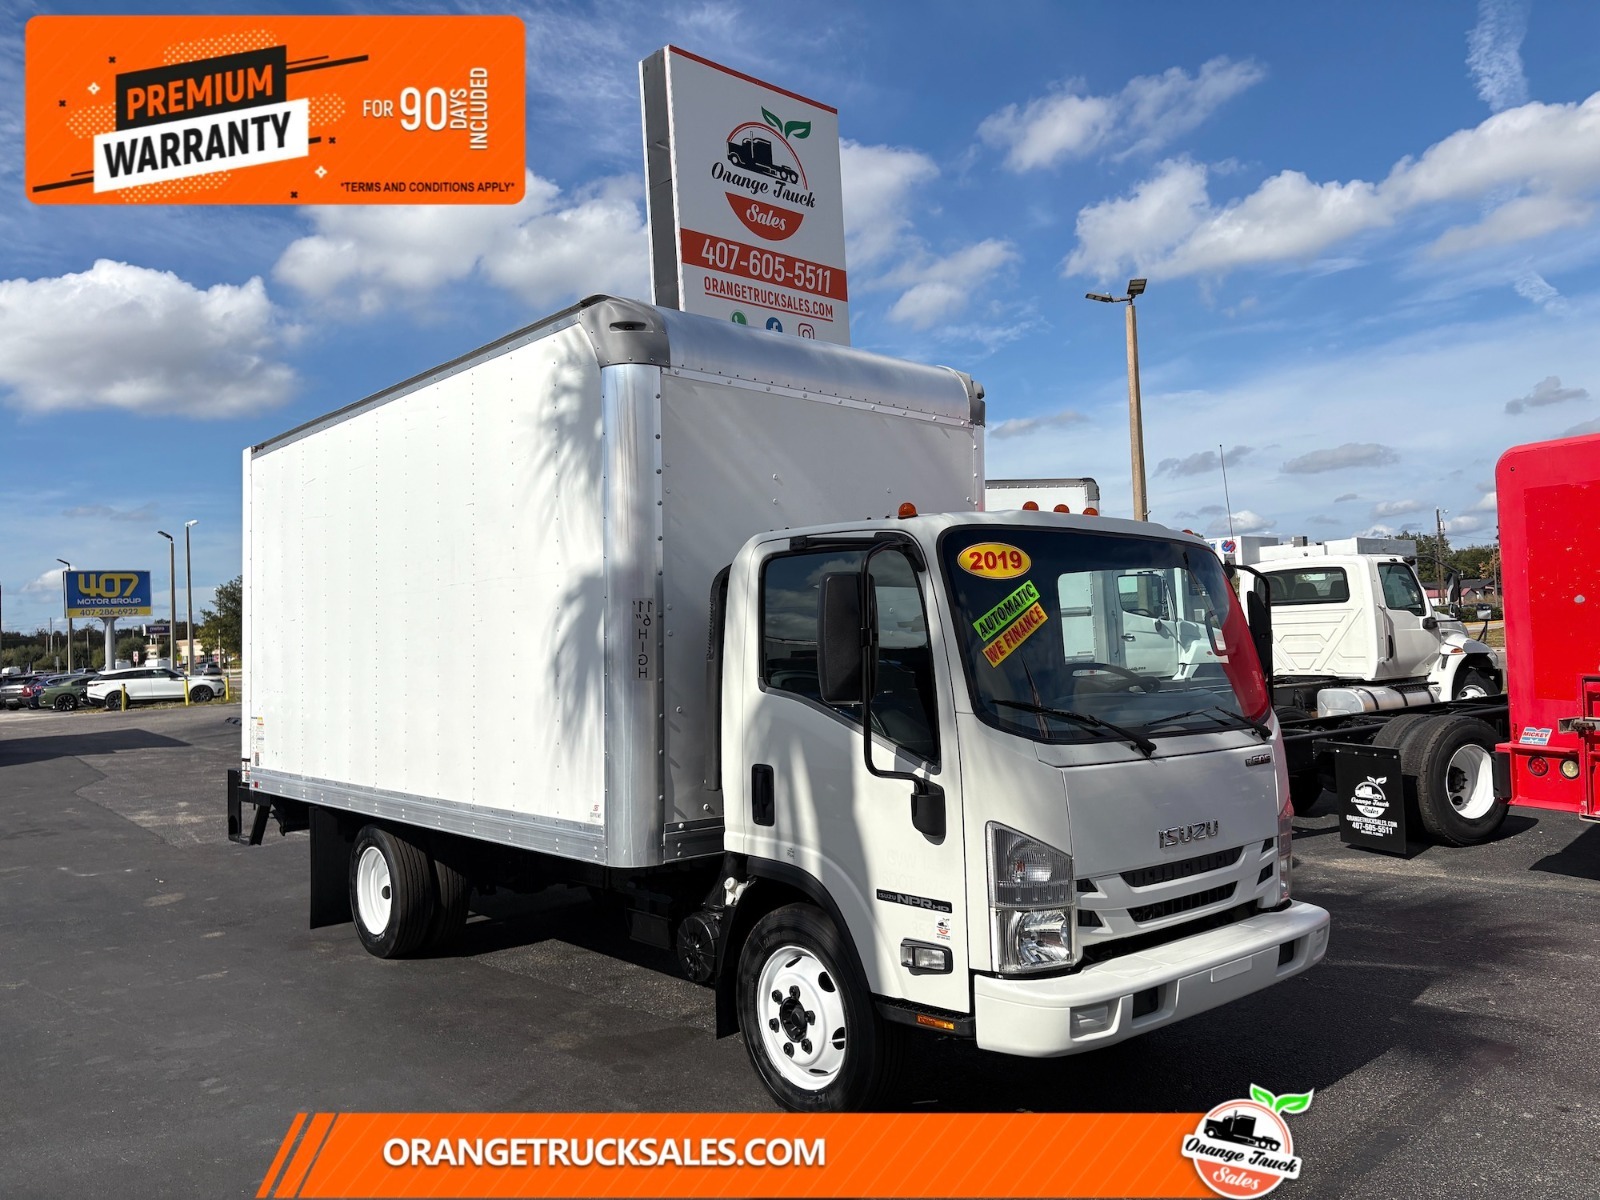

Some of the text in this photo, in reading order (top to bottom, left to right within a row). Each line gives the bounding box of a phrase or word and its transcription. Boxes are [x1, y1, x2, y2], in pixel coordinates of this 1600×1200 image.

[711, 161, 816, 208] Orange Truck
[746, 203, 787, 231] Sales
[701, 238, 832, 295] 407-605-5511
[703, 275, 834, 319] ORANGETRUCKSALES.COM
[969, 551, 1022, 570] 2019
[78, 573, 139, 597] 407
[80, 608, 138, 616] 407-286-6922
[978, 583, 1036, 638] AUTOMATIC
[984, 604, 1045, 664] WE FINANCE
[1158, 818, 1219, 850] ISUZU
[896, 893, 933, 909] NPR
[932, 904, 950, 912] HD
